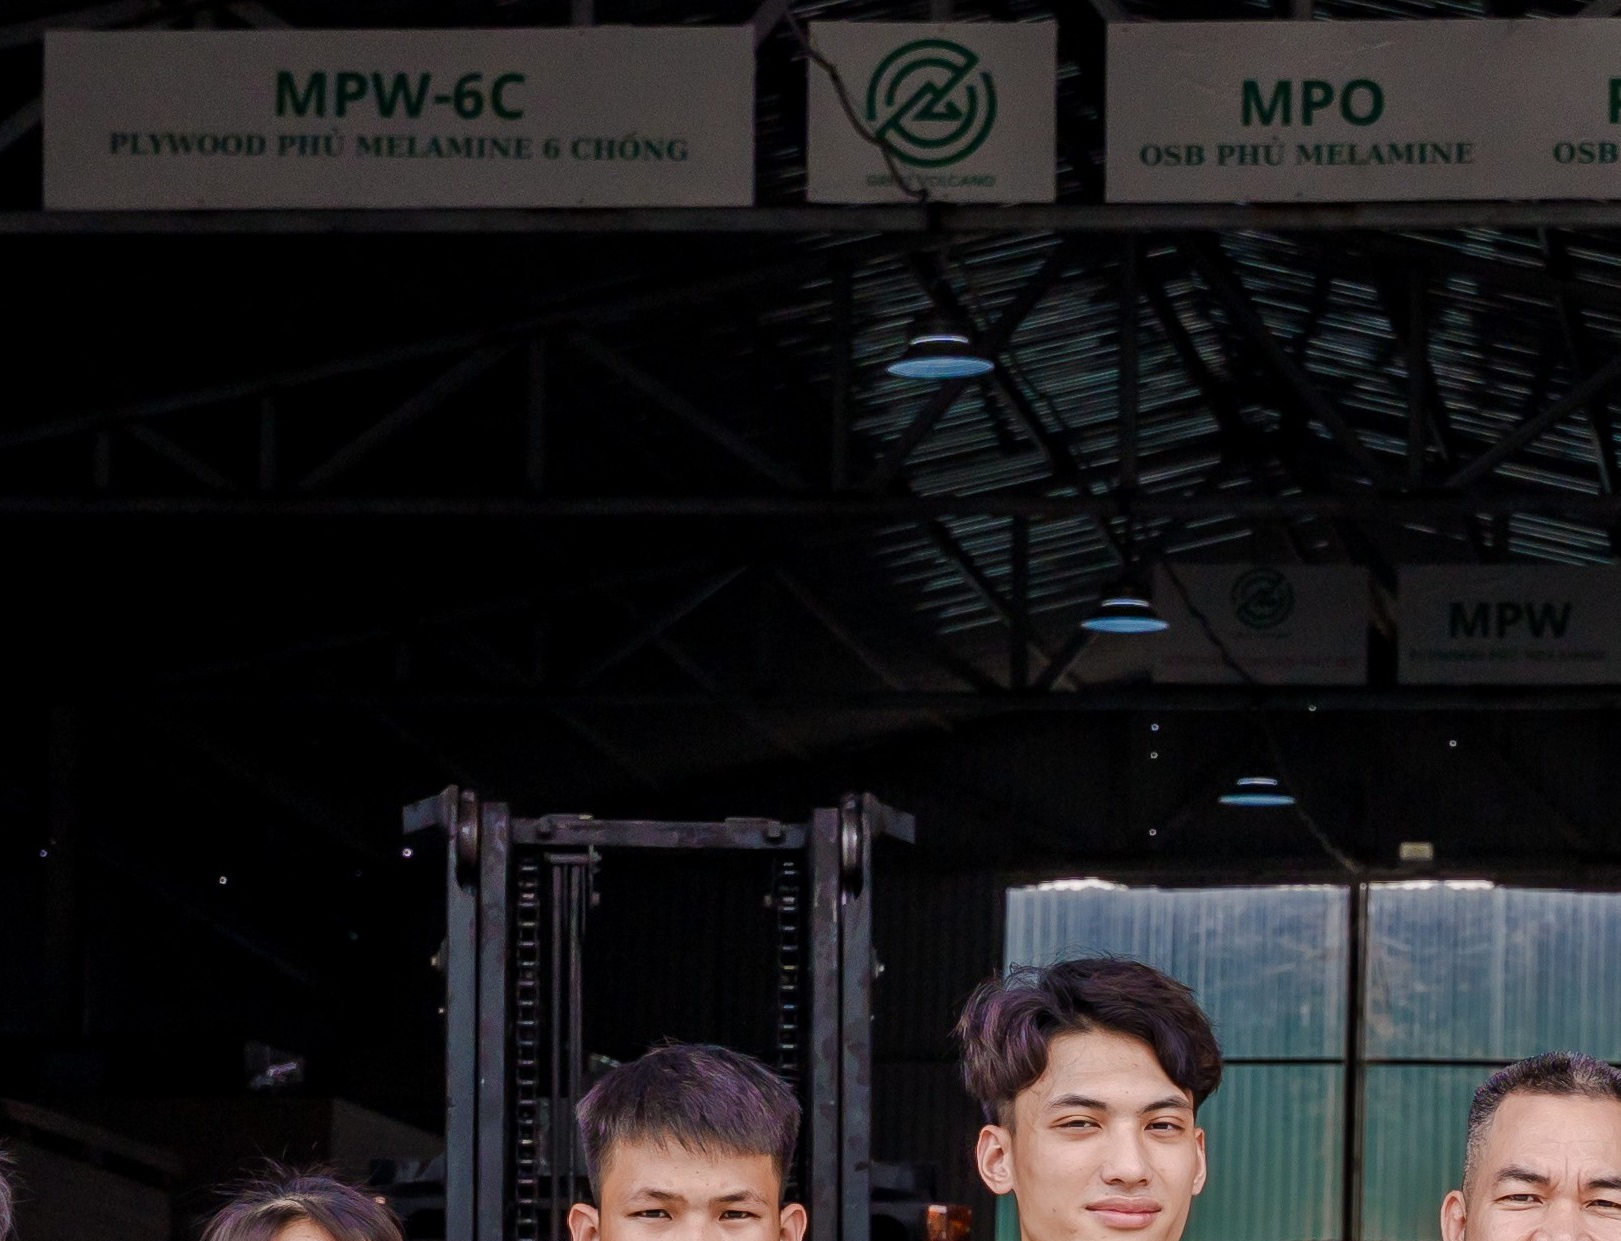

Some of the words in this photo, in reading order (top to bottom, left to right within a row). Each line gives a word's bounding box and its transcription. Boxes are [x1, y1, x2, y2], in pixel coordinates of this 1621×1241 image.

[275, 70, 526, 120] MPW-6C
[1241, 78, 1385, 127] MPO
[109, 131, 266, 157] PLYWOOD
[356, 133, 531, 160] MELAMINE
[543, 135, 561, 160] 6
[1139, 143, 1205, 167] OSB
[1296, 141, 1474, 167] MELAMINE
[1552, 141, 1618, 166] OSB
[1448, 603, 1572, 639] MPW
